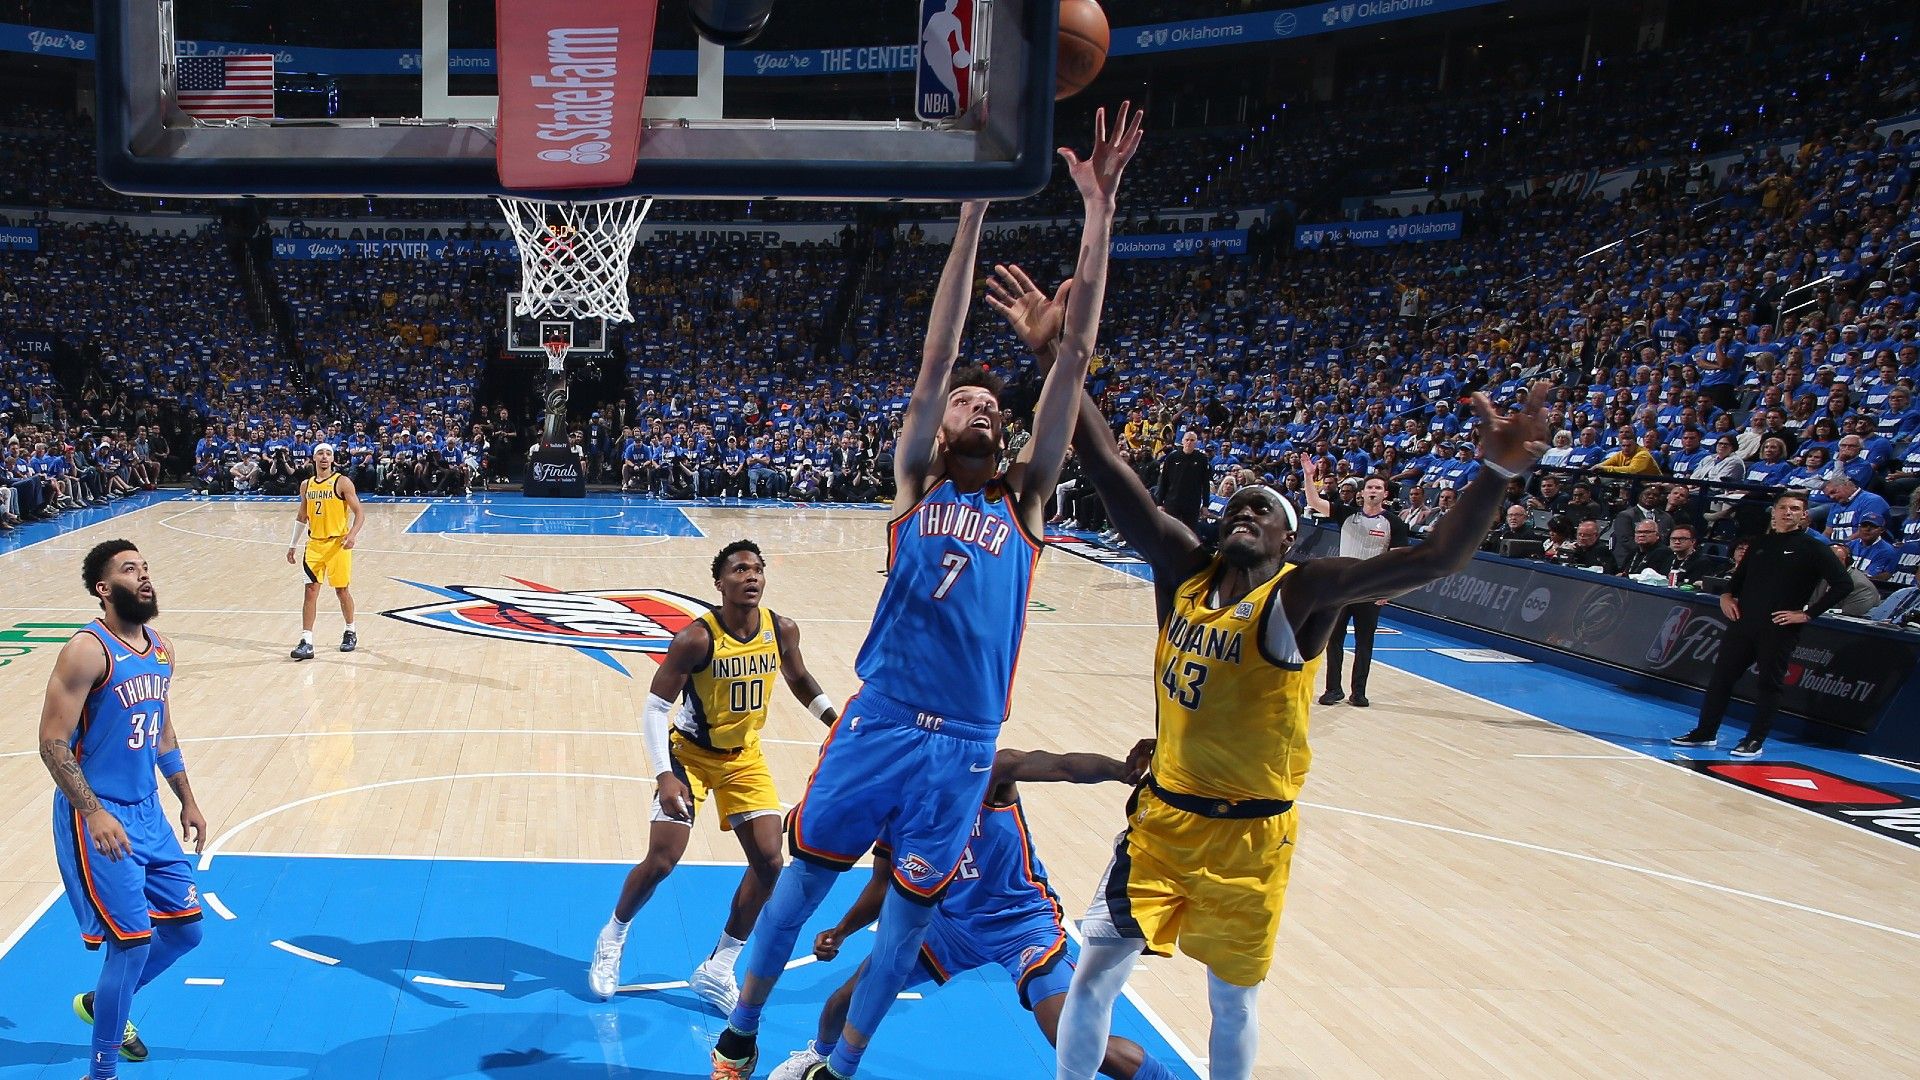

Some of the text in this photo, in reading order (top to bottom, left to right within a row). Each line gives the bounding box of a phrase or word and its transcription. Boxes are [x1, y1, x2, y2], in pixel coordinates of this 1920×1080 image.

[1358, 0, 1433, 18] Oklahoma
[28, 30, 87, 51] You're
[1171, 23, 1243, 42] Oklahoma
[449, 57, 490, 67] ahoma
[753, 45, 918, 73] You're THE CENTER
[923, 93, 950, 114] NBA
[1326, 228, 1379, 241] Okhoma
[1409, 222, 1457, 235] Oklahoma
[0, 233, 33, 244] lahoma
[654, 230, 782, 247] THUNDER
[1116, 241, 1166, 253] Oklahoma
[1195, 238, 1242, 249] Oahoma
[540, 463, 578, 482] Finals
[315, 501, 322, 515] 2
[918, 503, 1011, 557] THUNDER
[932, 551, 970, 600] 7
[1494, 585, 1519, 612] ET
[1524, 594, 1550, 610] abc
[712, 652, 778, 679] INDIANA
[114, 673, 170, 710] THUNDE
[1161, 655, 1209, 712] 43
[1798, 668, 1876, 702] YouTube TV
[729, 679, 765, 713] 00
[128, 711, 161, 750] 34
[916, 712, 944, 731] OKC
[904, 860, 928, 874] OKC
